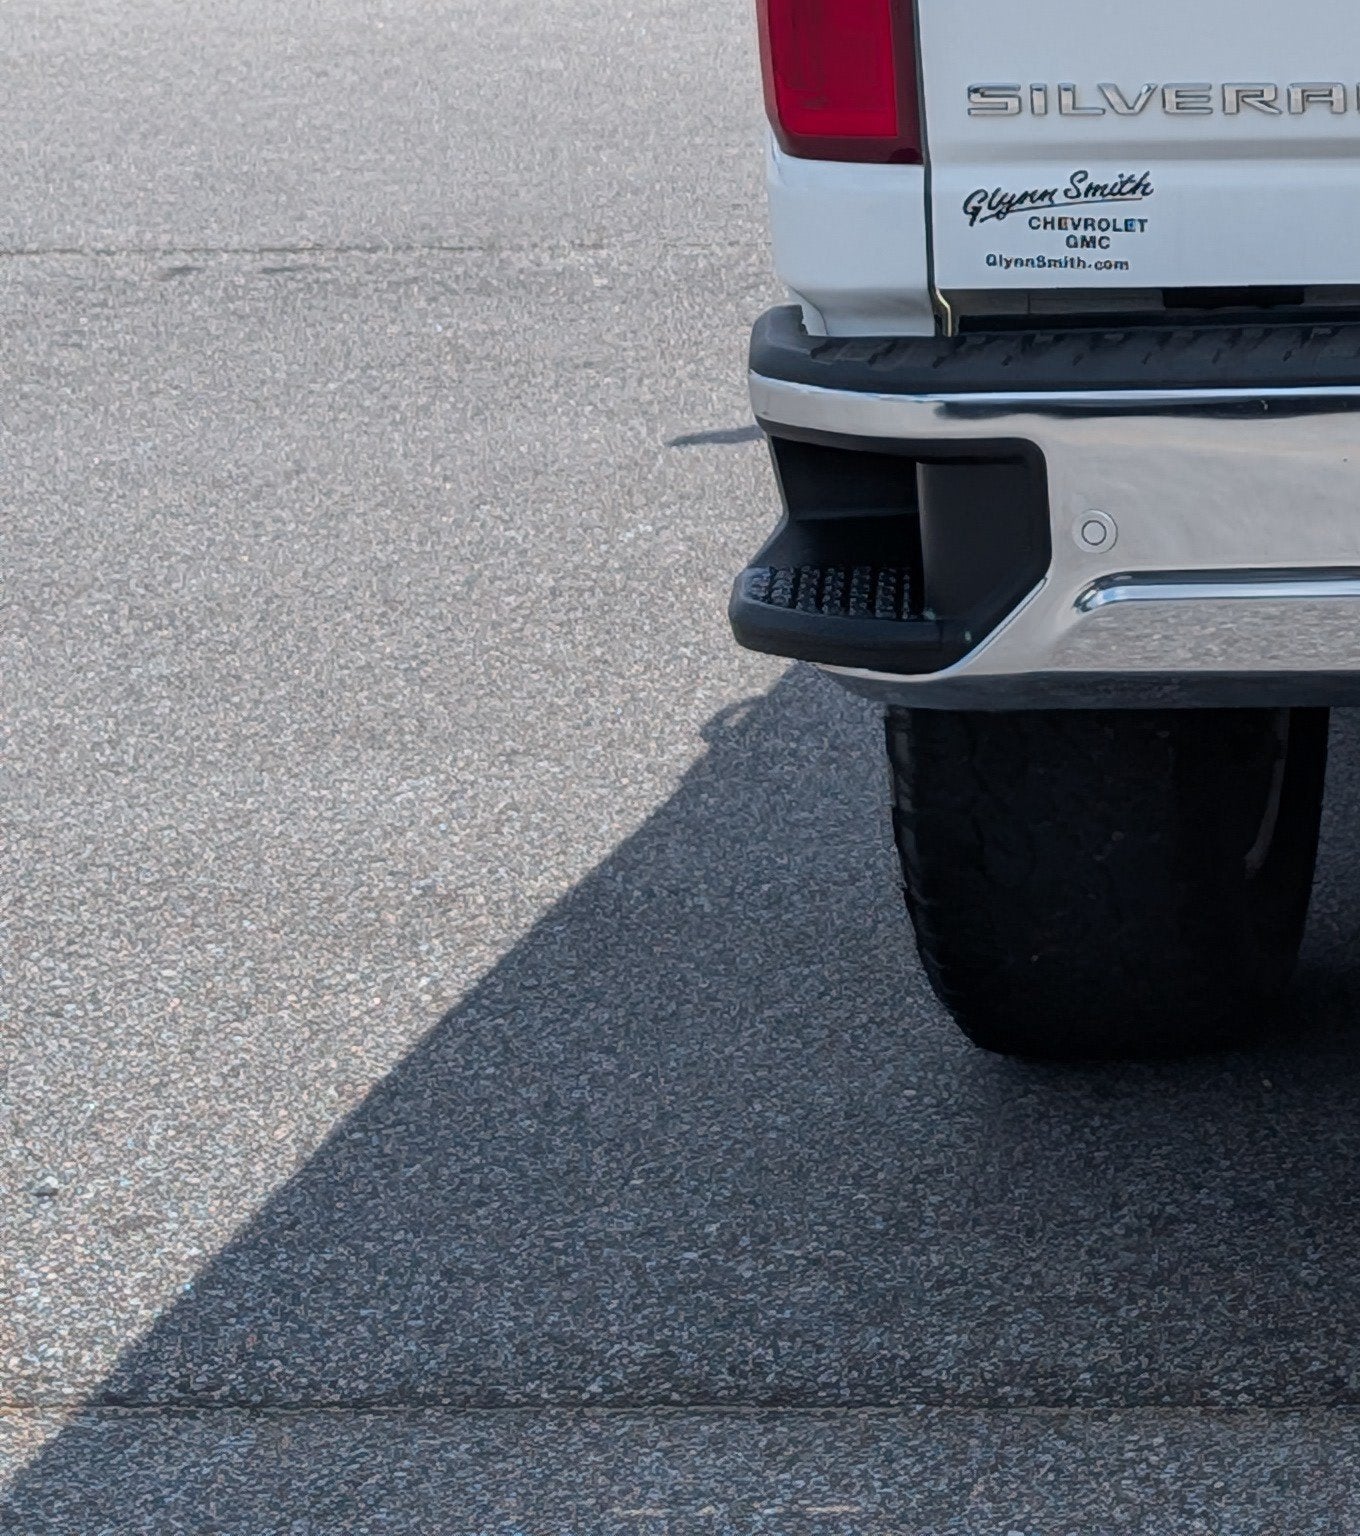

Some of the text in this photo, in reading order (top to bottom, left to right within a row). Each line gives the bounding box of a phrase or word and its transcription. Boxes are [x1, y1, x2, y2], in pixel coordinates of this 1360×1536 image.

[962, 169, 1155, 226] Glynn Smith
[1027, 215, 1149, 233] CHEVROLET
[1065, 235, 1111, 251] GMC
[984, 253, 1130, 271] GlynnSmith.com
